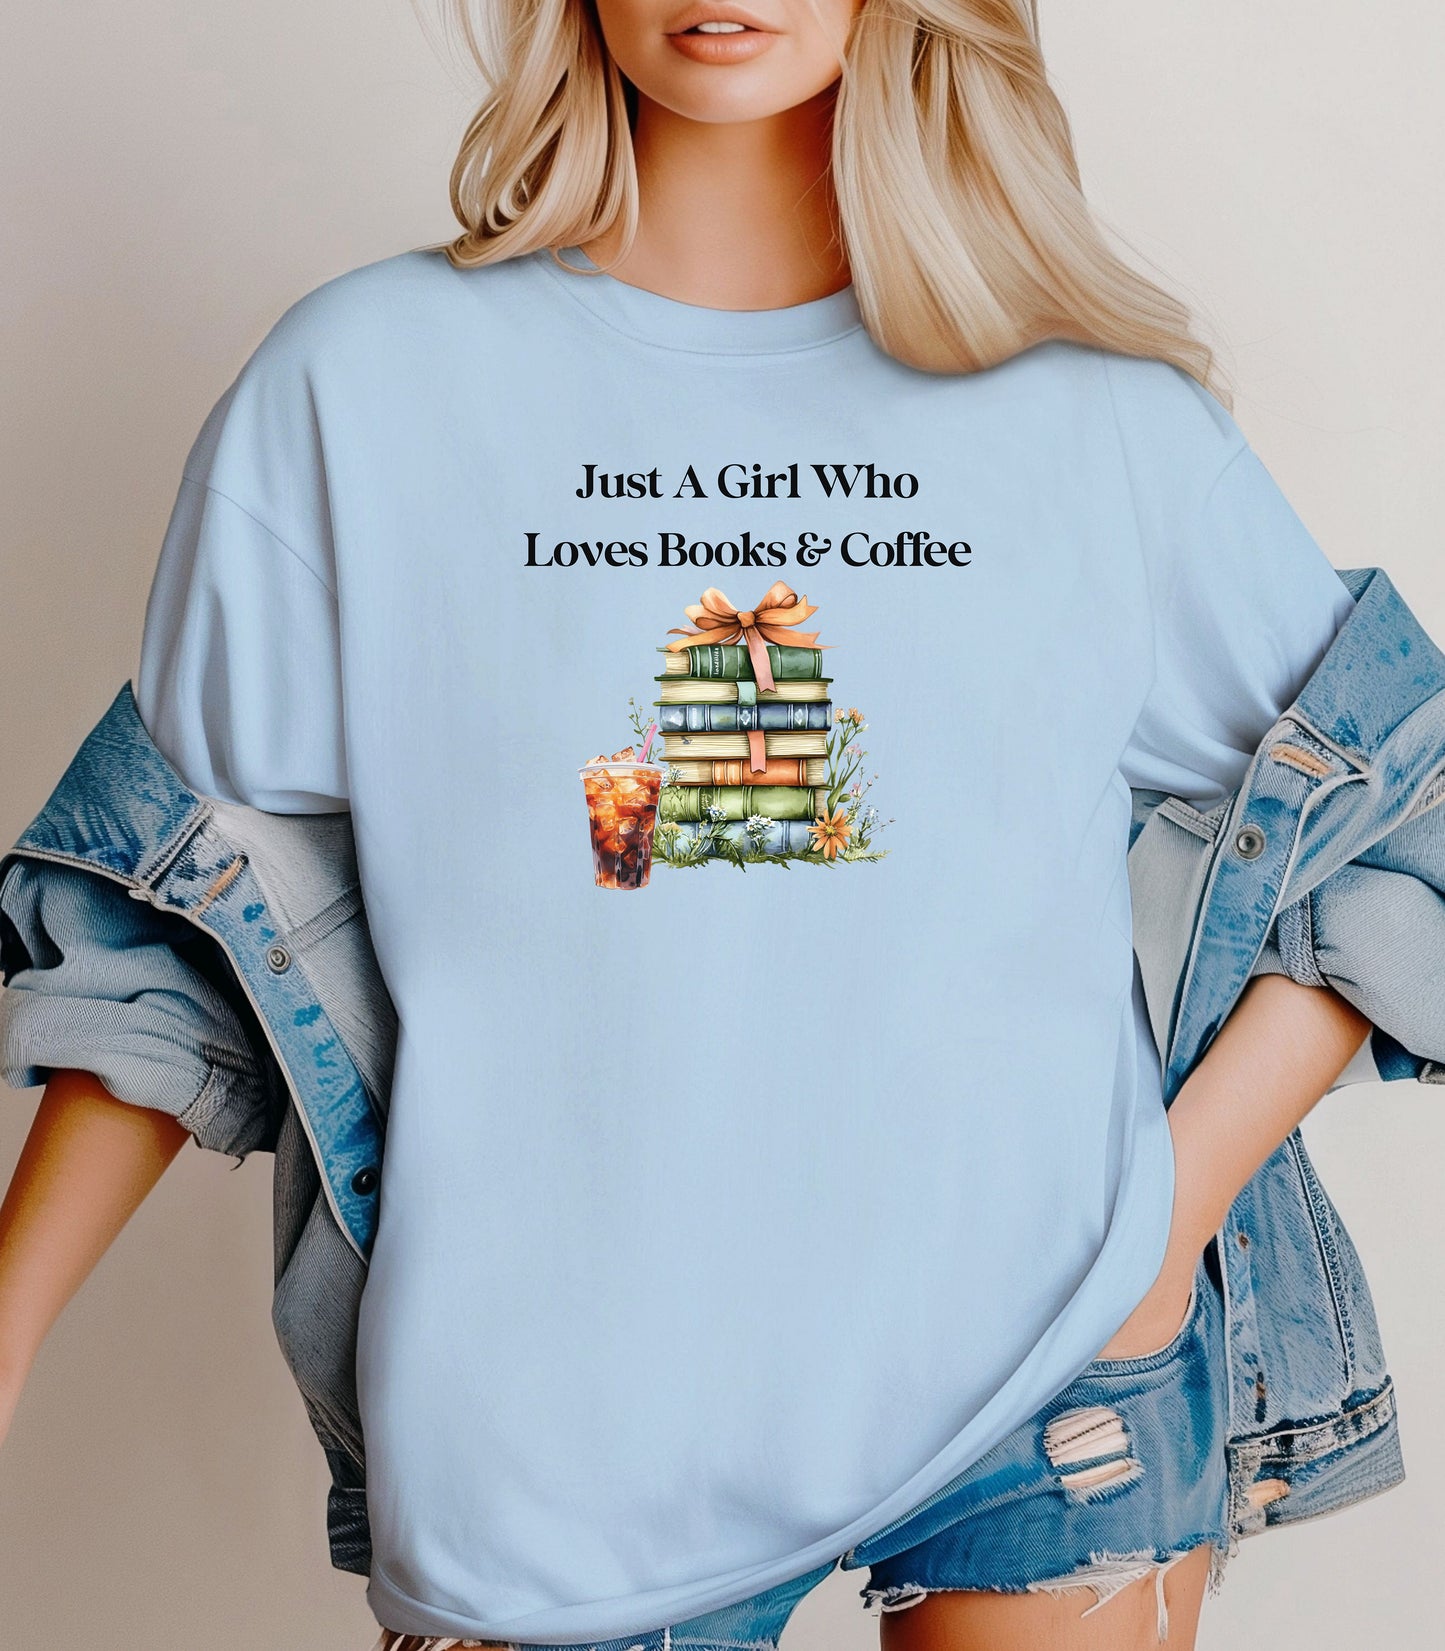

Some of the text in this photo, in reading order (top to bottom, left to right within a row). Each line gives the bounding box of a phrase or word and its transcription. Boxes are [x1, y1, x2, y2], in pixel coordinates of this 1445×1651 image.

[575, 463, 919, 499] Just A Girl Who
[523, 531, 972, 567] Loves Books & Coffee
